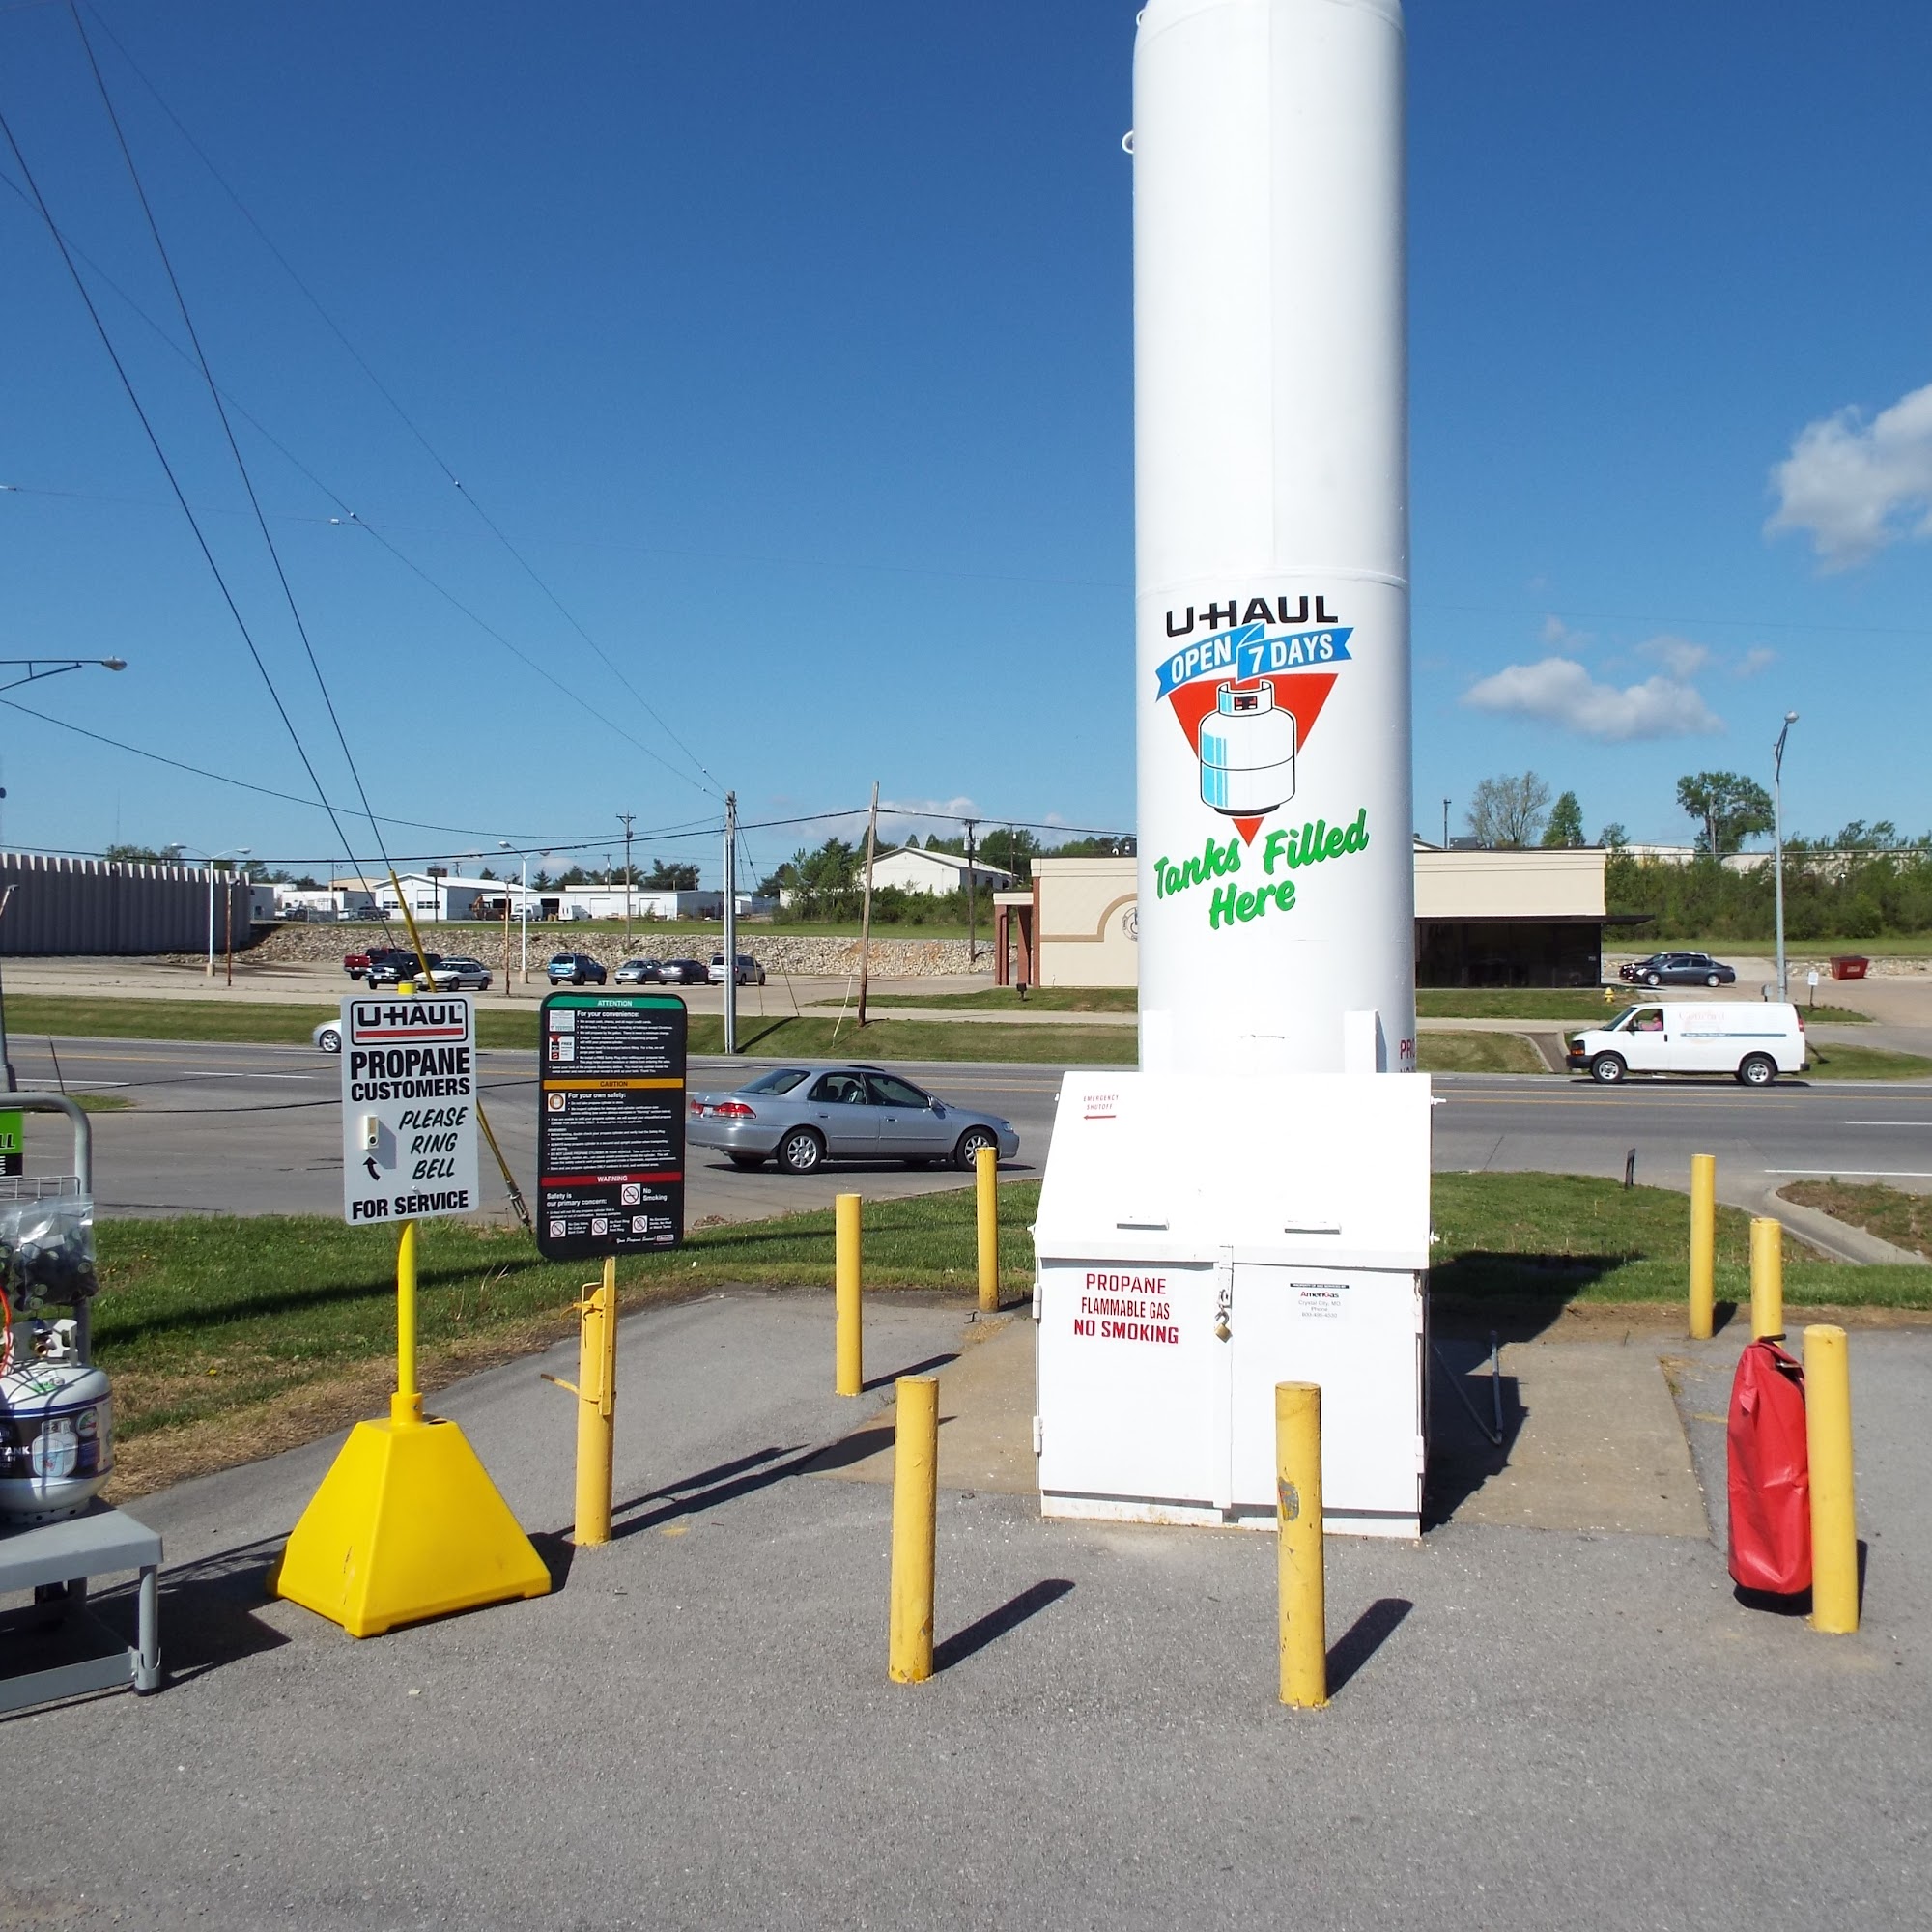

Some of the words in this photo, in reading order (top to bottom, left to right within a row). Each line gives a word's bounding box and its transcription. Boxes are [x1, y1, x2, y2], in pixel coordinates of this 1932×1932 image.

[1166, 595, 1339, 638] U-HAUL
[1171, 635, 1232, 684] OPEN
[1248, 645, 1262, 674] 7
[1270, 633, 1334, 668] DAYS
[1153, 837, 1241, 900] Tanks
[1263, 807, 1370, 876] Filled
[1208, 879, 1297, 931] Here
[357, 1004, 463, 1027] U-HAUL
[351, 1047, 470, 1080] PROPANE
[351, 1077, 470, 1102] CUSTOMERS
[399, 1107, 469, 1130] PLEASE
[411, 1132, 458, 1155] RING
[412, 1158, 456, 1180] BELL
[352, 1198, 388, 1220] FOR
[394, 1190, 469, 1215] SERVICE
[1086, 1273, 1167, 1294] PROPANE
[1081, 1296, 1146, 1318] FLAMMABLE
[1150, 1301, 1170, 1320] GAS
[1074, 1319, 1095, 1337] NO
[1101, 1321, 1179, 1344] SMOKING
